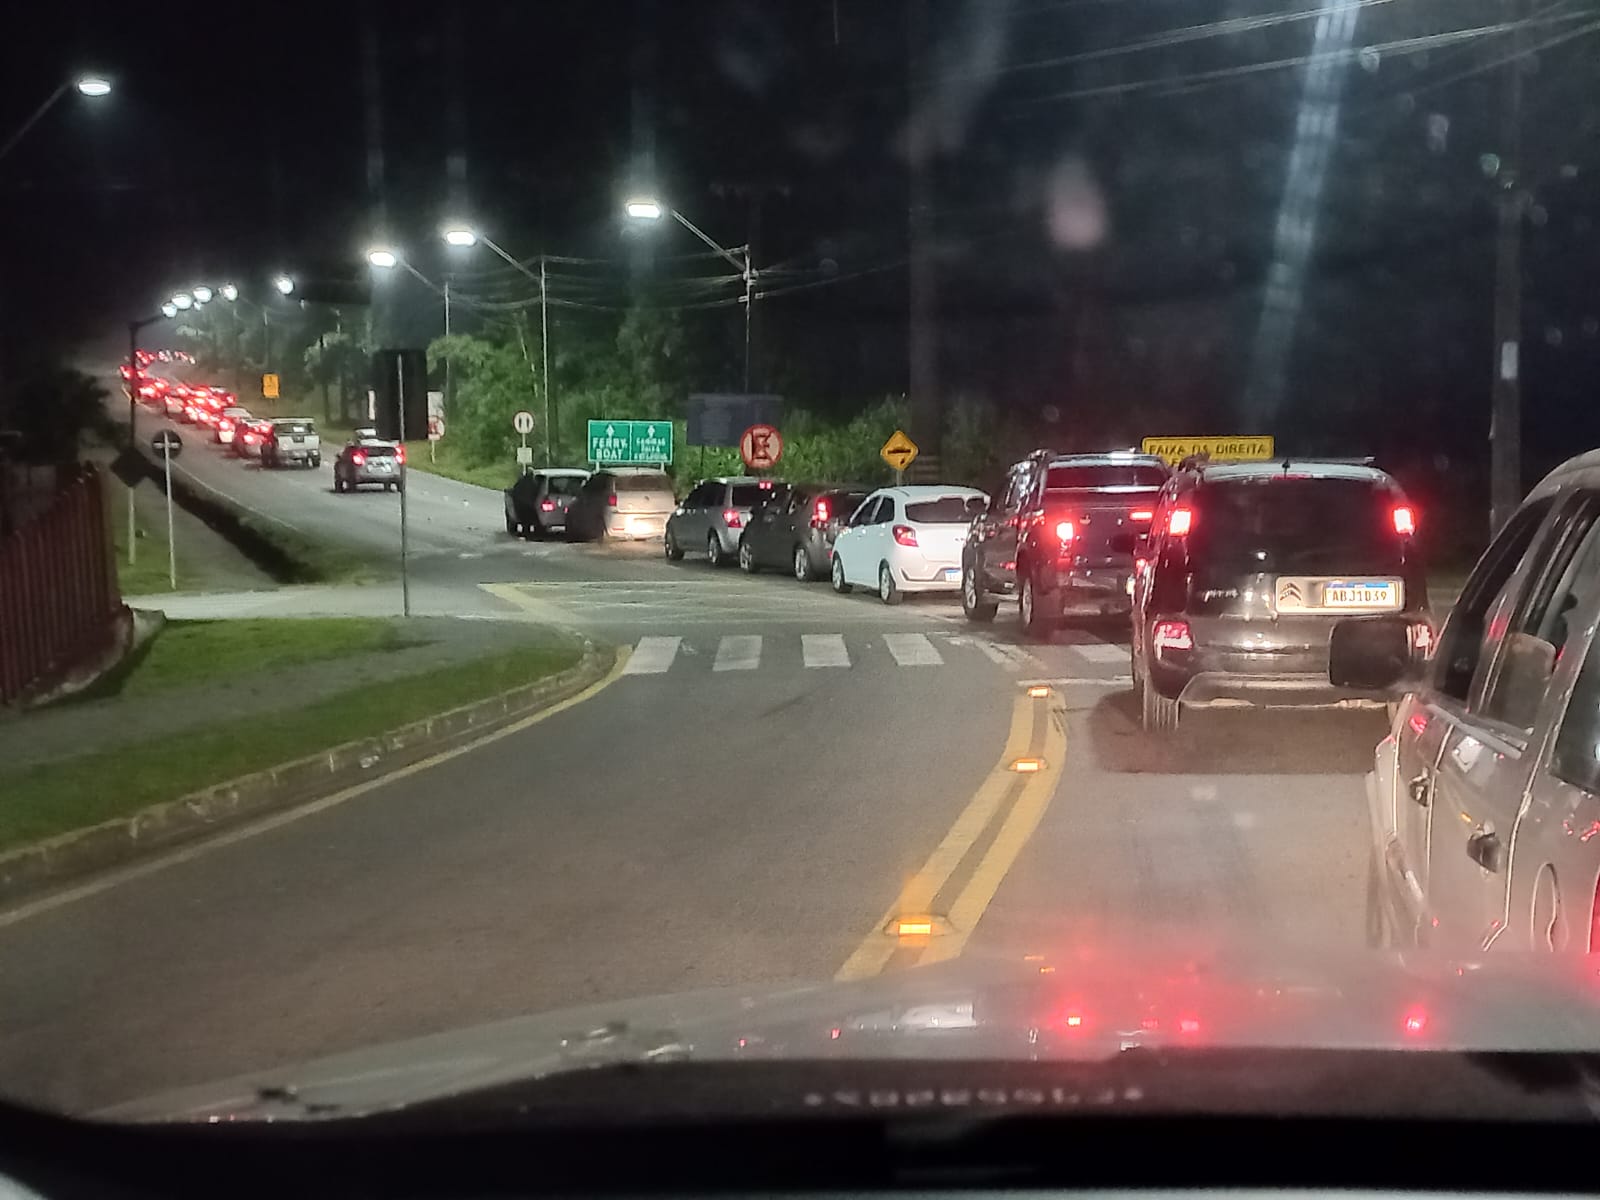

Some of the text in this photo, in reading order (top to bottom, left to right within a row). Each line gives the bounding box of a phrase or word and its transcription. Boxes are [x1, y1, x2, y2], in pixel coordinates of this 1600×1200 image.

[596, 448, 622, 460] BOAT
[1149, 444, 1186, 455] FAIXA
[1216, 443, 1265, 455] DIREITA
